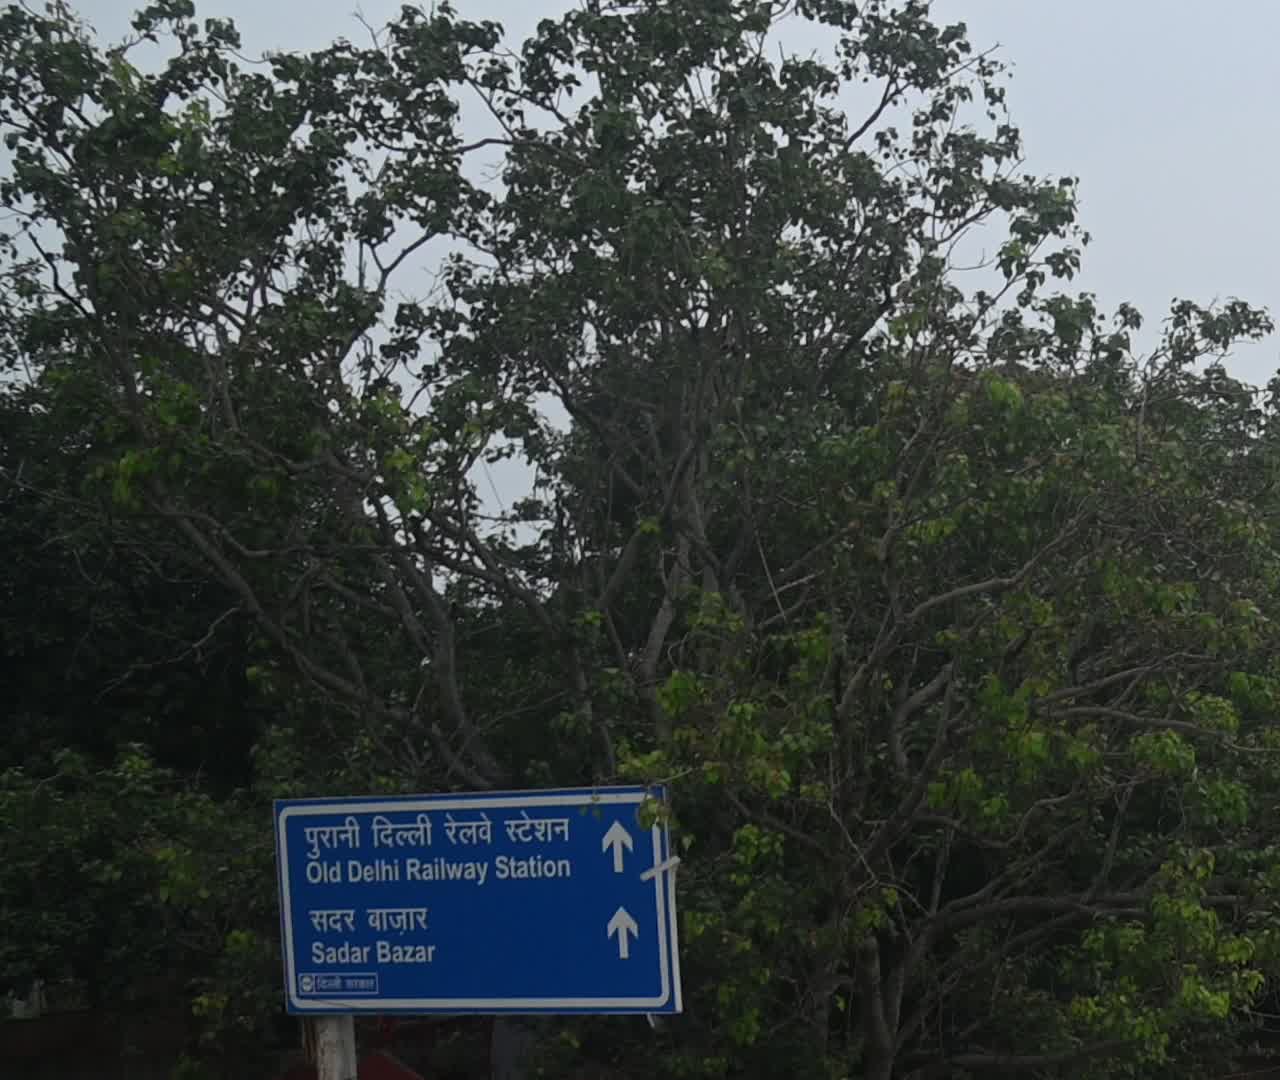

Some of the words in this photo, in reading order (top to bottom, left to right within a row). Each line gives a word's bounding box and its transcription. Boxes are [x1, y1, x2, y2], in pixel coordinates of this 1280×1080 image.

[304, 815, 360, 859] पुरानी
[372, 813, 432, 848] दिल्ली
[444, 811, 492, 847] रेलवे
[504, 809, 569, 843] स्टेशन
[305, 861, 341, 884] Old
[348, 858, 399, 882] Delhi
[406, 857, 488, 886] Railway
[495, 855, 571, 880] Station
[308, 908, 356, 932] सदर
[366, 906, 429, 936] बाज़ार
[311, 940, 370, 964] Sadar
[376, 938, 436, 963] Bazar
